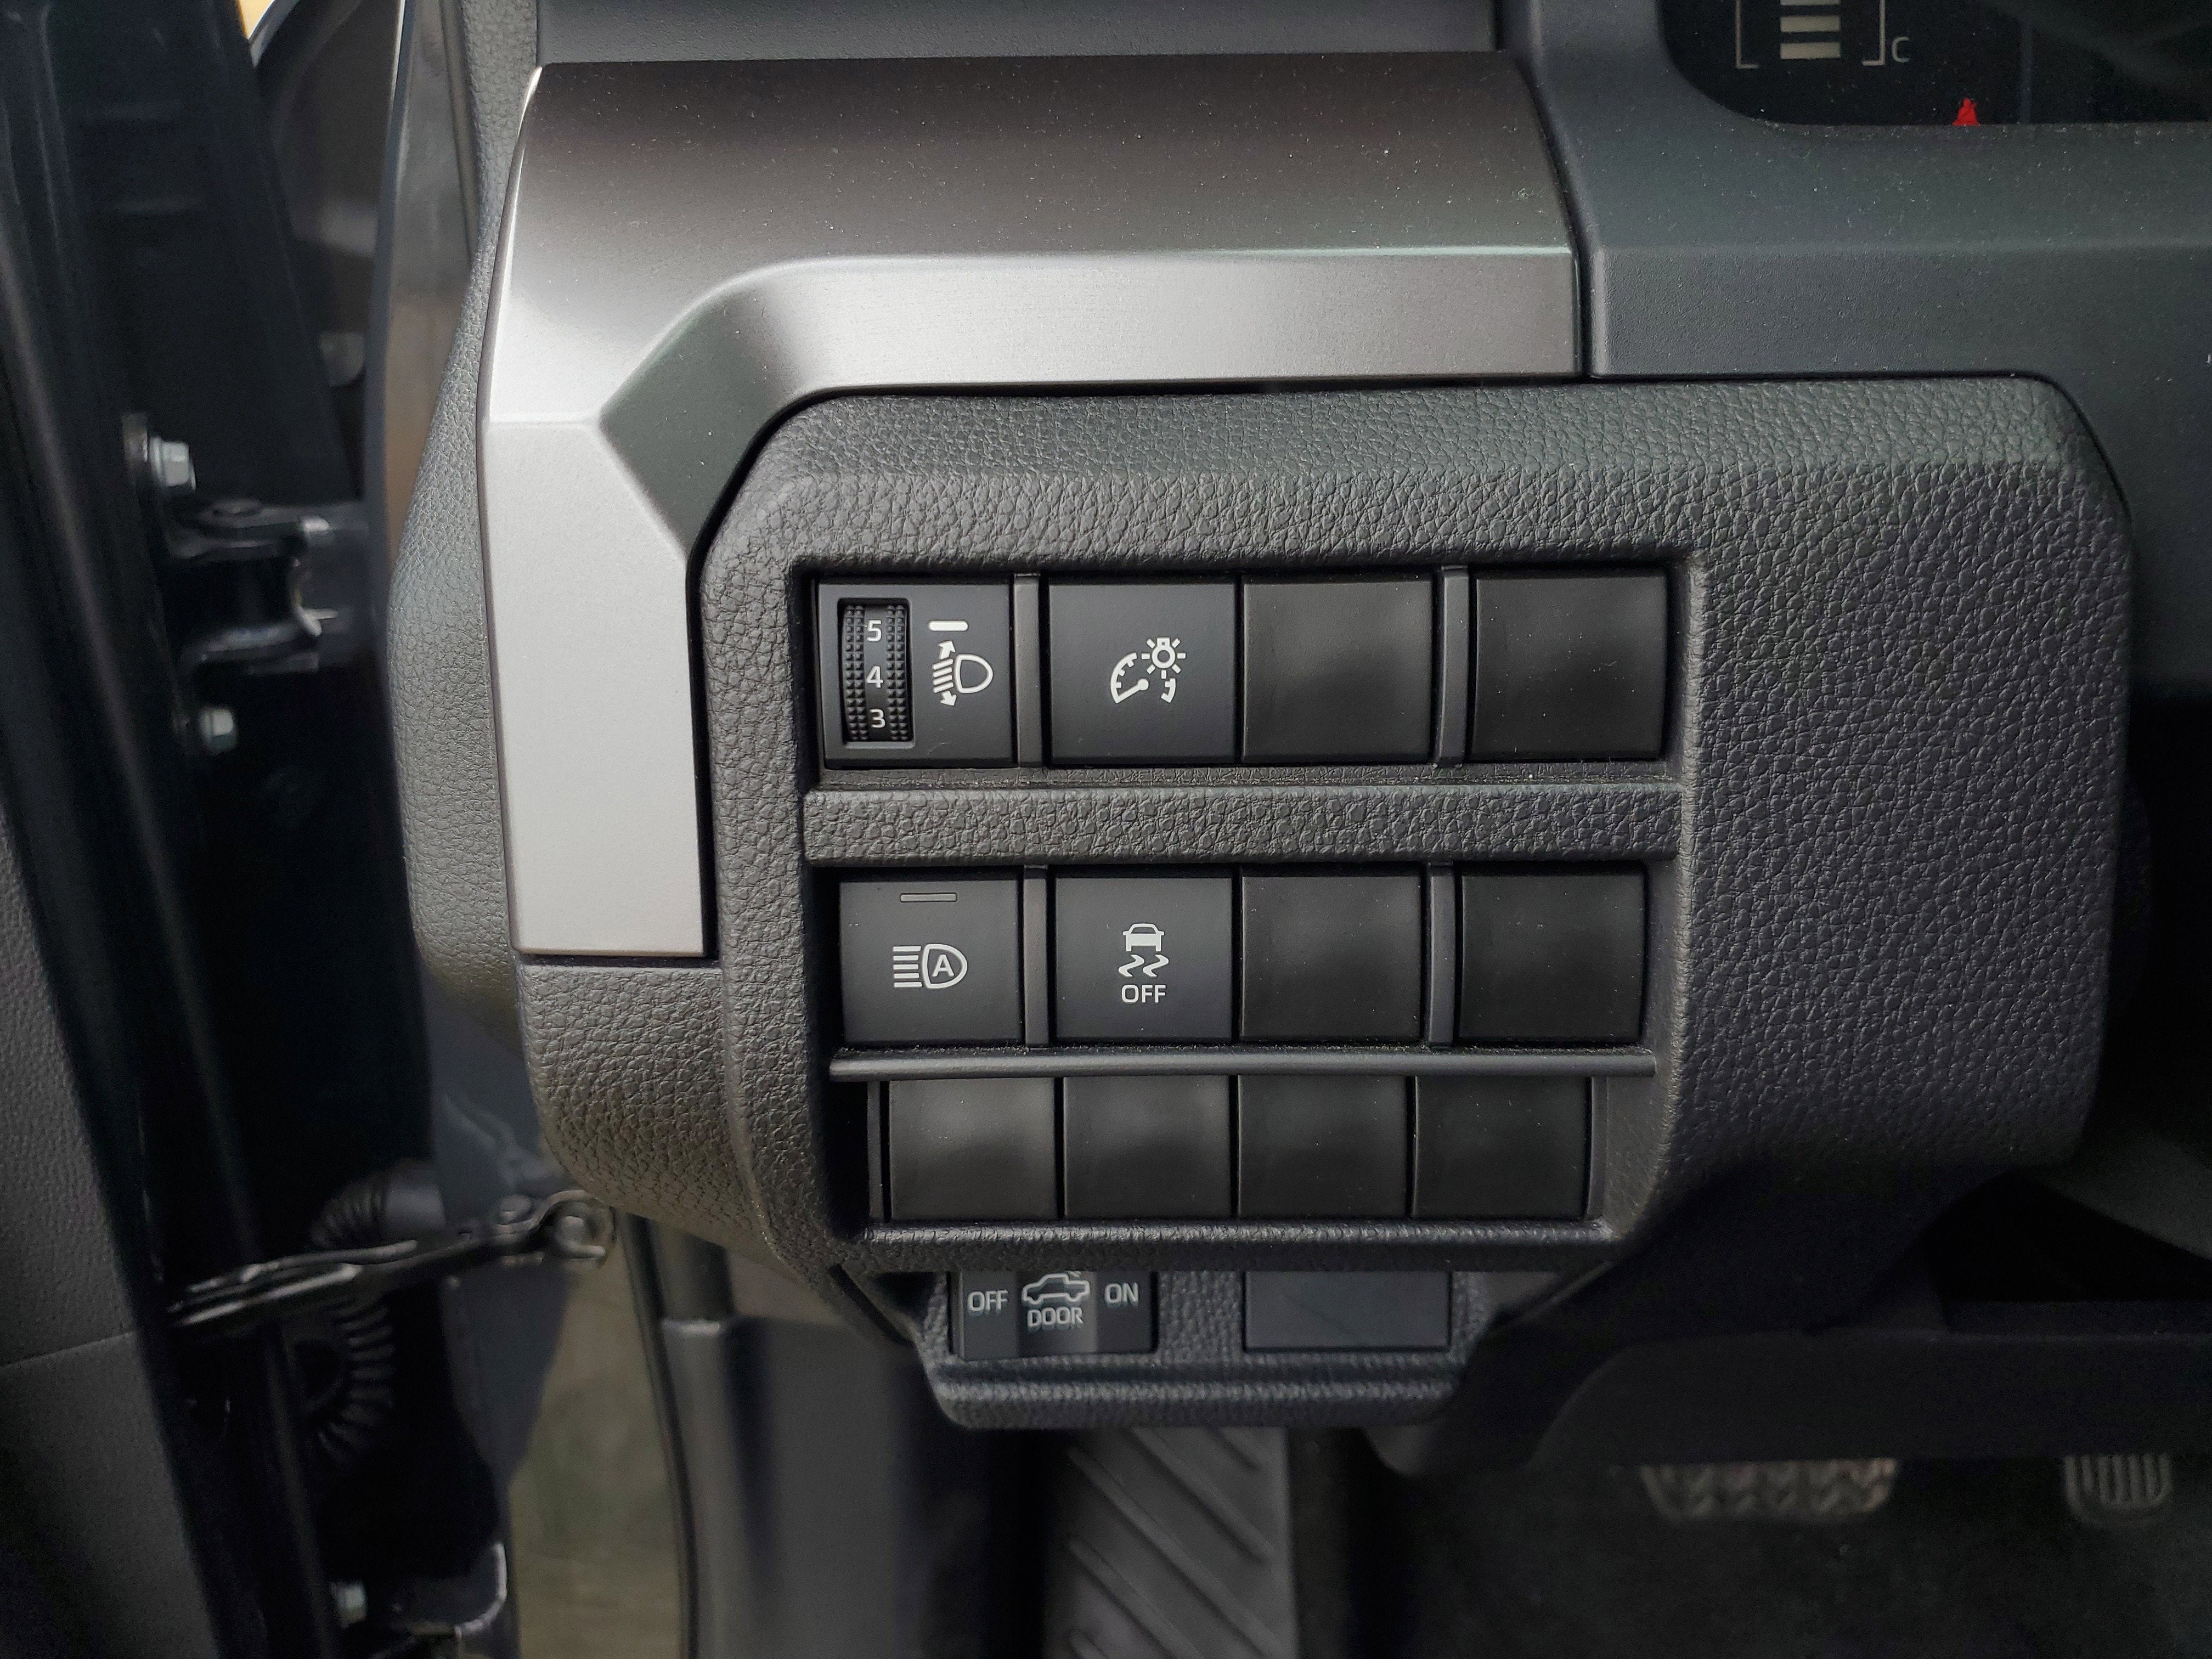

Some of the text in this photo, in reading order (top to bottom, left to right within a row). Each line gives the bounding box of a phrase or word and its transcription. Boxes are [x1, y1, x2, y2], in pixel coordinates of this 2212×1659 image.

[1891, 36, 1910, 63] C
[866, 619, 882, 642] 5
[866, 665, 884, 689] 4
[869, 708, 886, 729] 3
[932, 953, 955, 977] A
[1121, 984, 1166, 1003] OFF
[967, 1289, 1008, 1312] OFF
[1104, 1282, 1139, 1305] ON
[1027, 1307, 1084, 1328] DOOR
